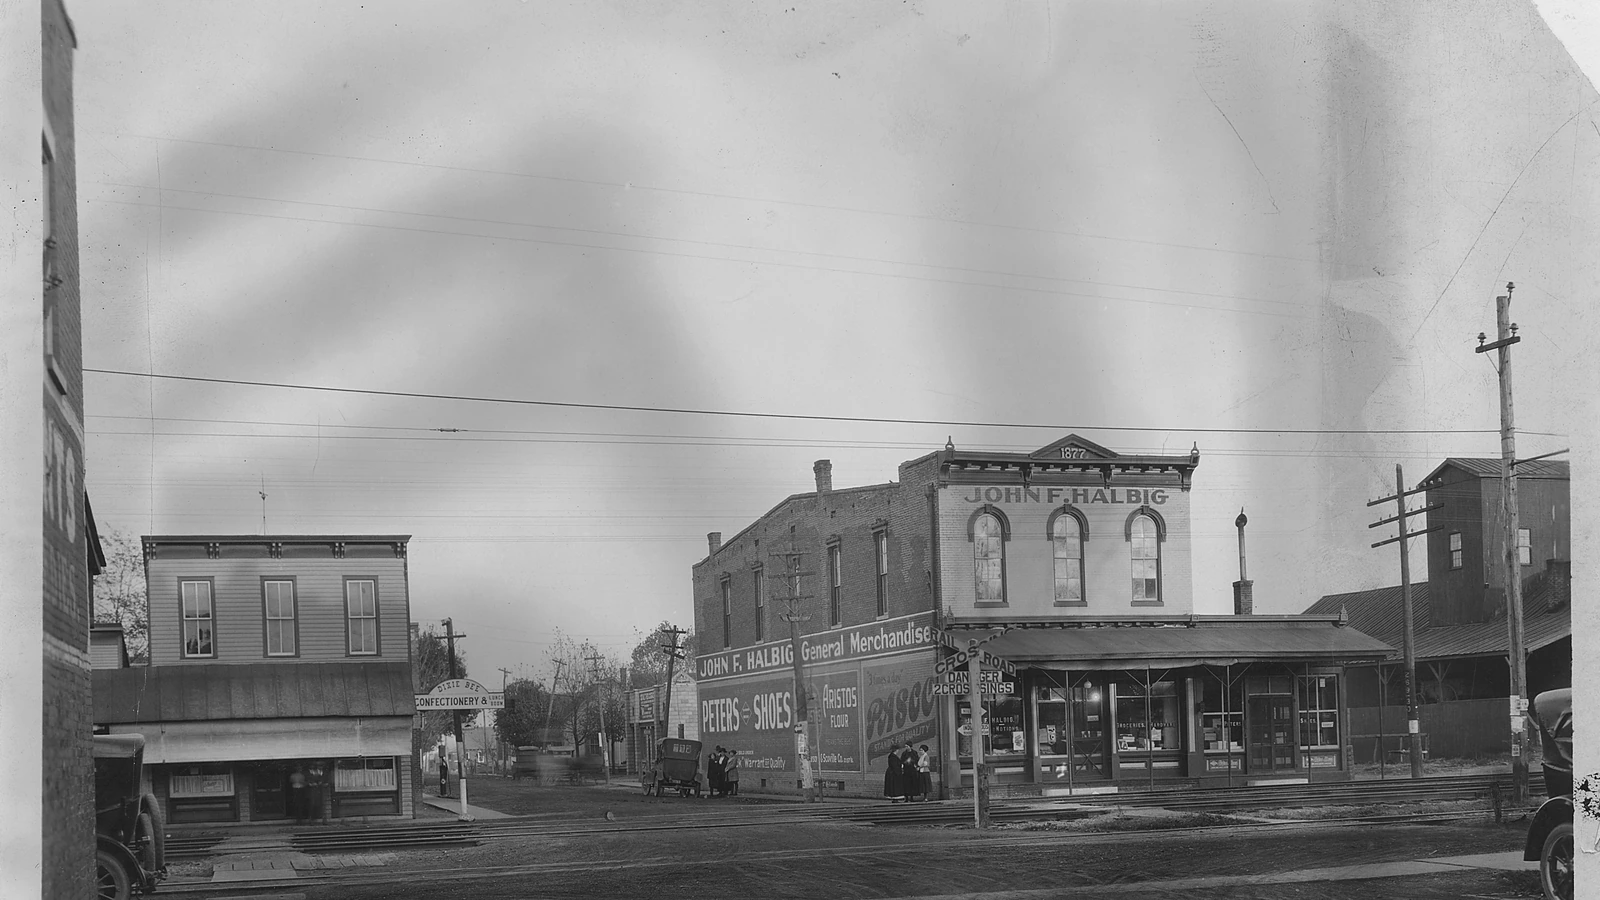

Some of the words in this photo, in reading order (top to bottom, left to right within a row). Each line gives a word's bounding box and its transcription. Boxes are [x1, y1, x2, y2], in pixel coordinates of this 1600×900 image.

[1060, 447, 1086, 459] 1877
[964, 486, 1041, 504] JOHN
[700, 656, 729, 677] JOHN
[733, 653, 743, 672] F.
[747, 644, 794, 670] HALBIG
[801, 634, 845, 662] General
[850, 621, 931, 654] Merchandise
[983, 651, 1015, 674] ROAD
[437, 680, 460, 693] DIXIE
[464, 681, 480, 693] BEE
[415, 696, 479, 707] CONFECTIONERY
[480, 696, 488, 705] &
[702, 697, 740, 733] PETERS
[753, 691, 791, 730] SHOES
[830, 714, 849, 728] FLOUR
